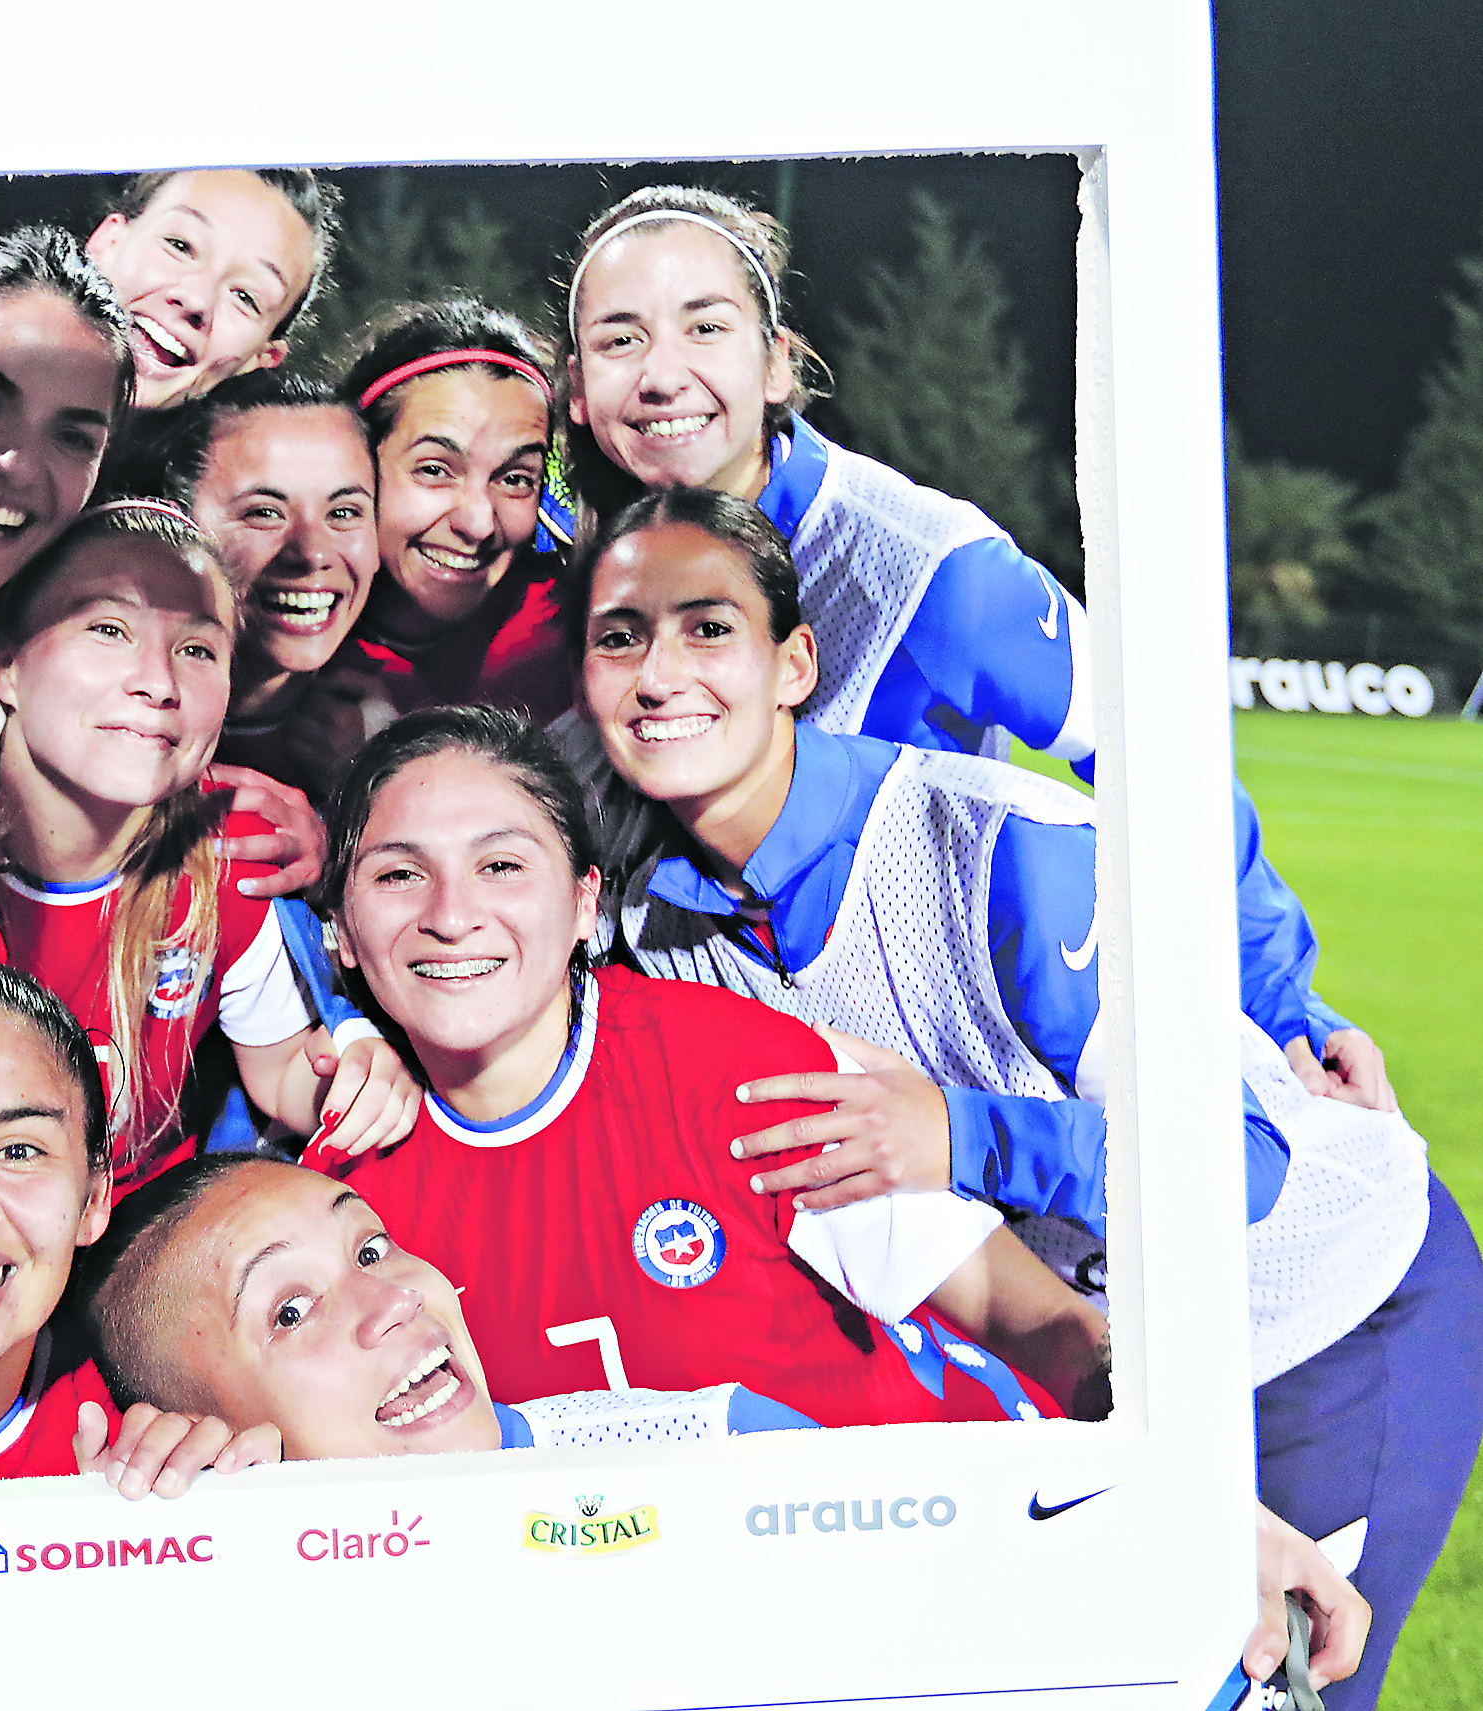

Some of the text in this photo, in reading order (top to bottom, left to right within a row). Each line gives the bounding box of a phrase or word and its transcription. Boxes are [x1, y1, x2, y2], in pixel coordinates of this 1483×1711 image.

[1230, 656, 1435, 718] rauco
[530, 1510, 651, 1548] CRISTAL
[745, 1495, 957, 1536] arauco
[16, 1535, 213, 1573] SODIMAC
[297, 1528, 409, 1561] Claro
